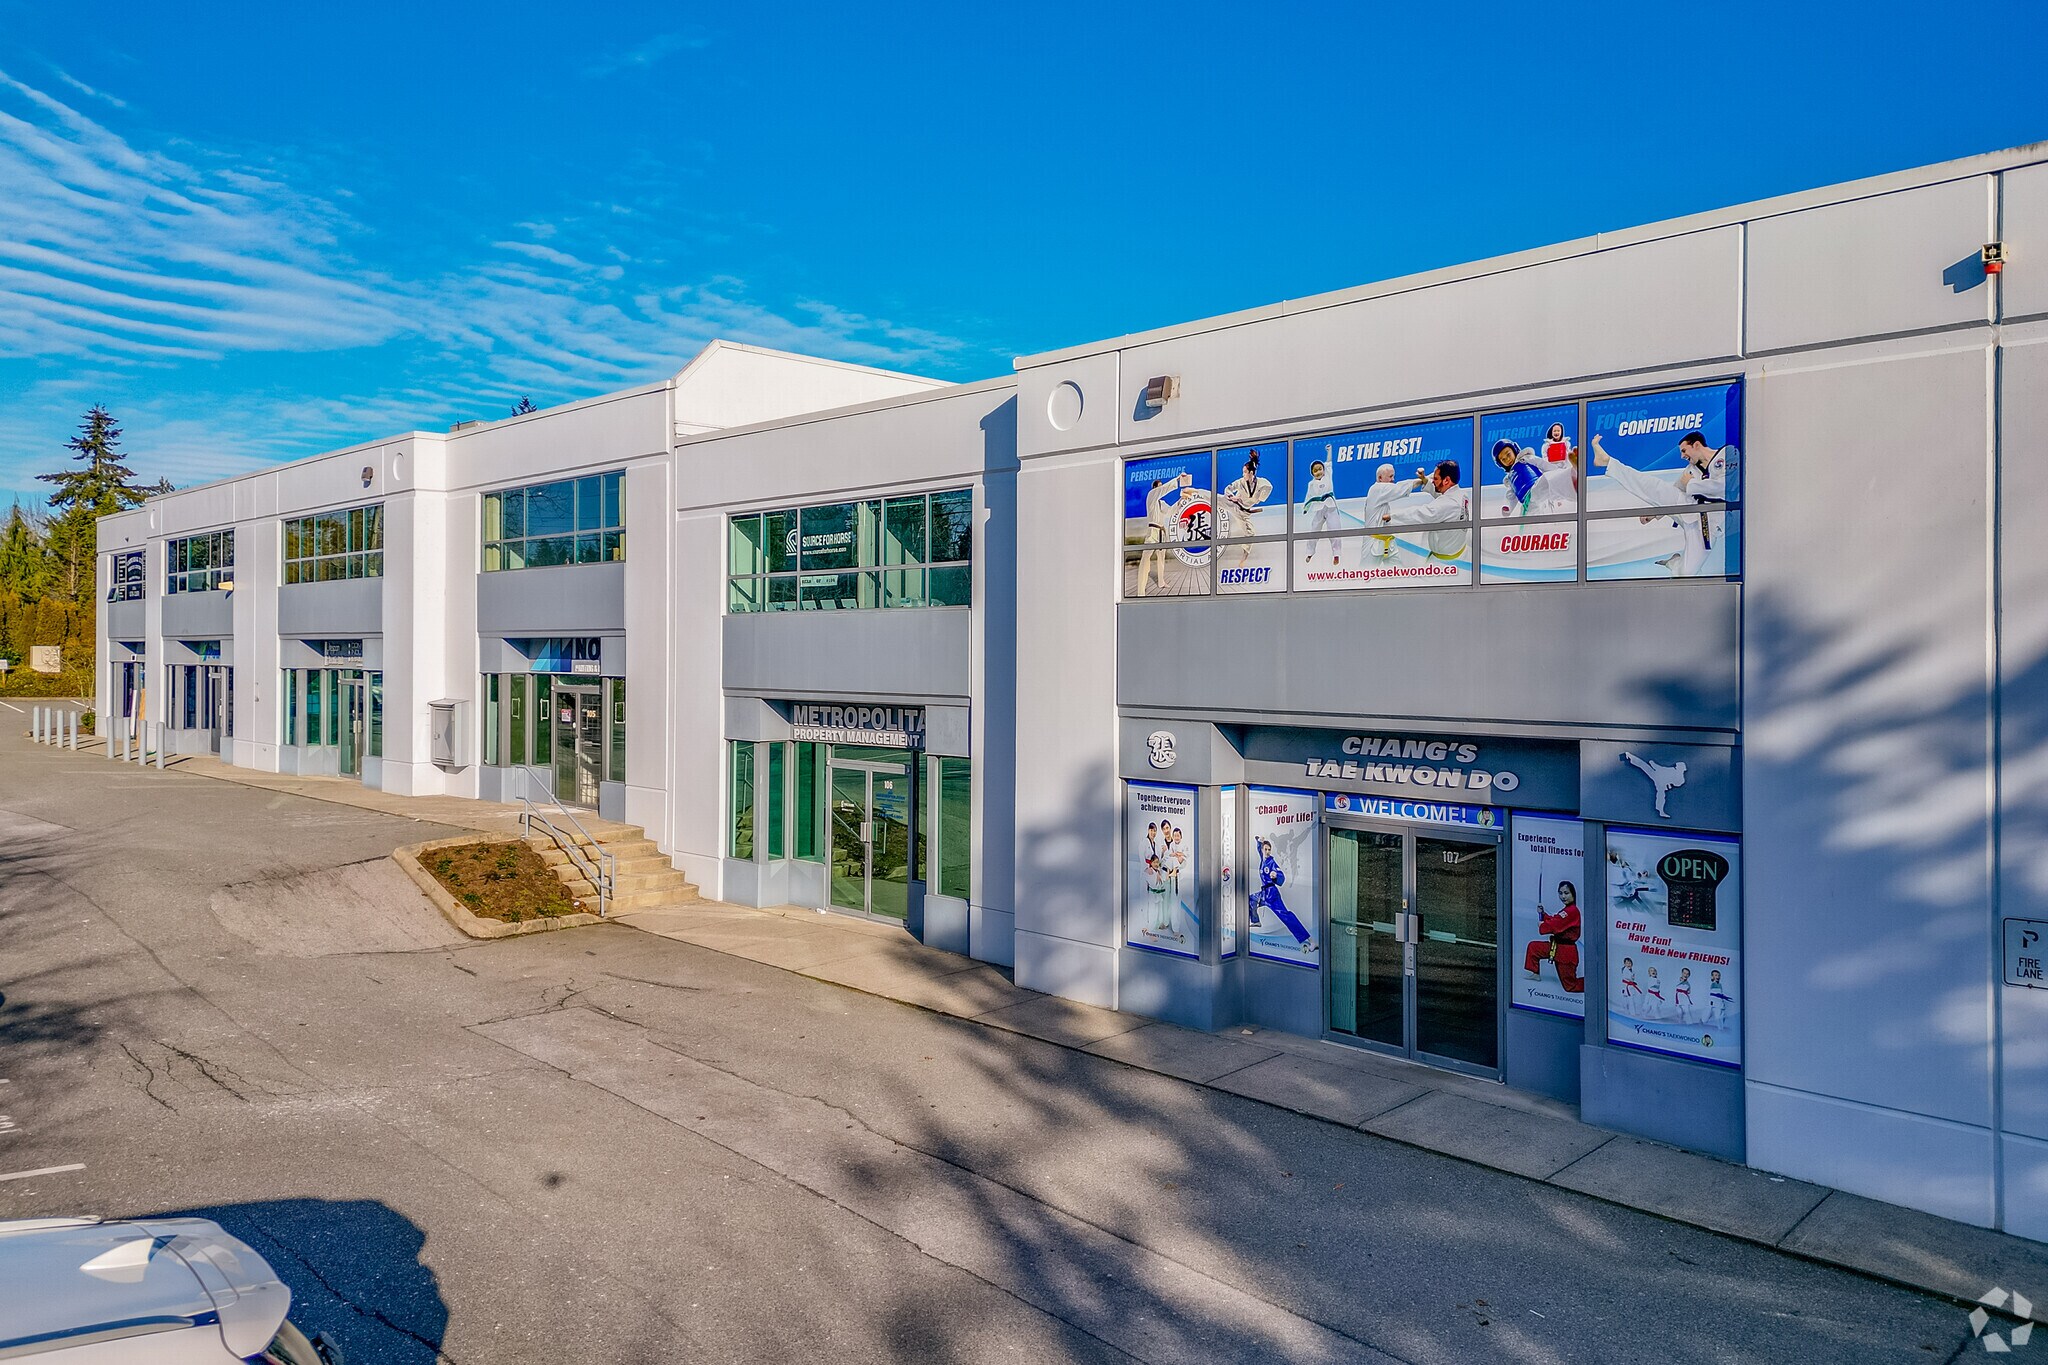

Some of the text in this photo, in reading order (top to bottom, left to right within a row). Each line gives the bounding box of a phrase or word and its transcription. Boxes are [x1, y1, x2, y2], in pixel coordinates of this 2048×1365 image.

[1487, 424, 1544, 442] INTEGRITY
[1618, 413, 1704, 437] CONFIDENCE
[1337, 437, 1423, 462] BE THE BEST!
[1394, 448, 1451, 465] LEADERSHIP
[802, 535, 822, 547] SOURCE
[1501, 533, 1570, 552] COURAGE
[1175, 548, 1204, 564] ARTIAL
[1220, 567, 1271, 584] RESPECT
[1307, 564, 1457, 581] www.changstaekwondo.ca
[793, 728, 845, 741] PROPERTY
[846, 730, 920, 747] MANAGEMENT
[1342, 736, 1478, 763] CHANG'S
[1305, 758, 1519, 792] TAE KWON DO
[1137, 792, 1191, 806] Together Everyone
[1140, 803, 1186, 815] achieves more!
[1359, 798, 1467, 823] WELCOME!
[1276, 815, 1295, 825] your
[1518, 832, 1556, 844] Experience
[1443, 851, 1460, 864] 107
[1530, 844, 1585, 857] total fitness for
[1664, 857, 1717, 880] OPEN
[1616, 920, 1647, 932] Get Fit!
[1628, 932, 1672, 946] Have Fun!
[1641, 945, 1731, 966] Make New FRIENDS!
[2018, 957, 2041, 970] FIRE
[2016, 967, 2043, 981] LANE
[1642, 1028, 1700, 1043] CHANG'S TAEKWONDO
